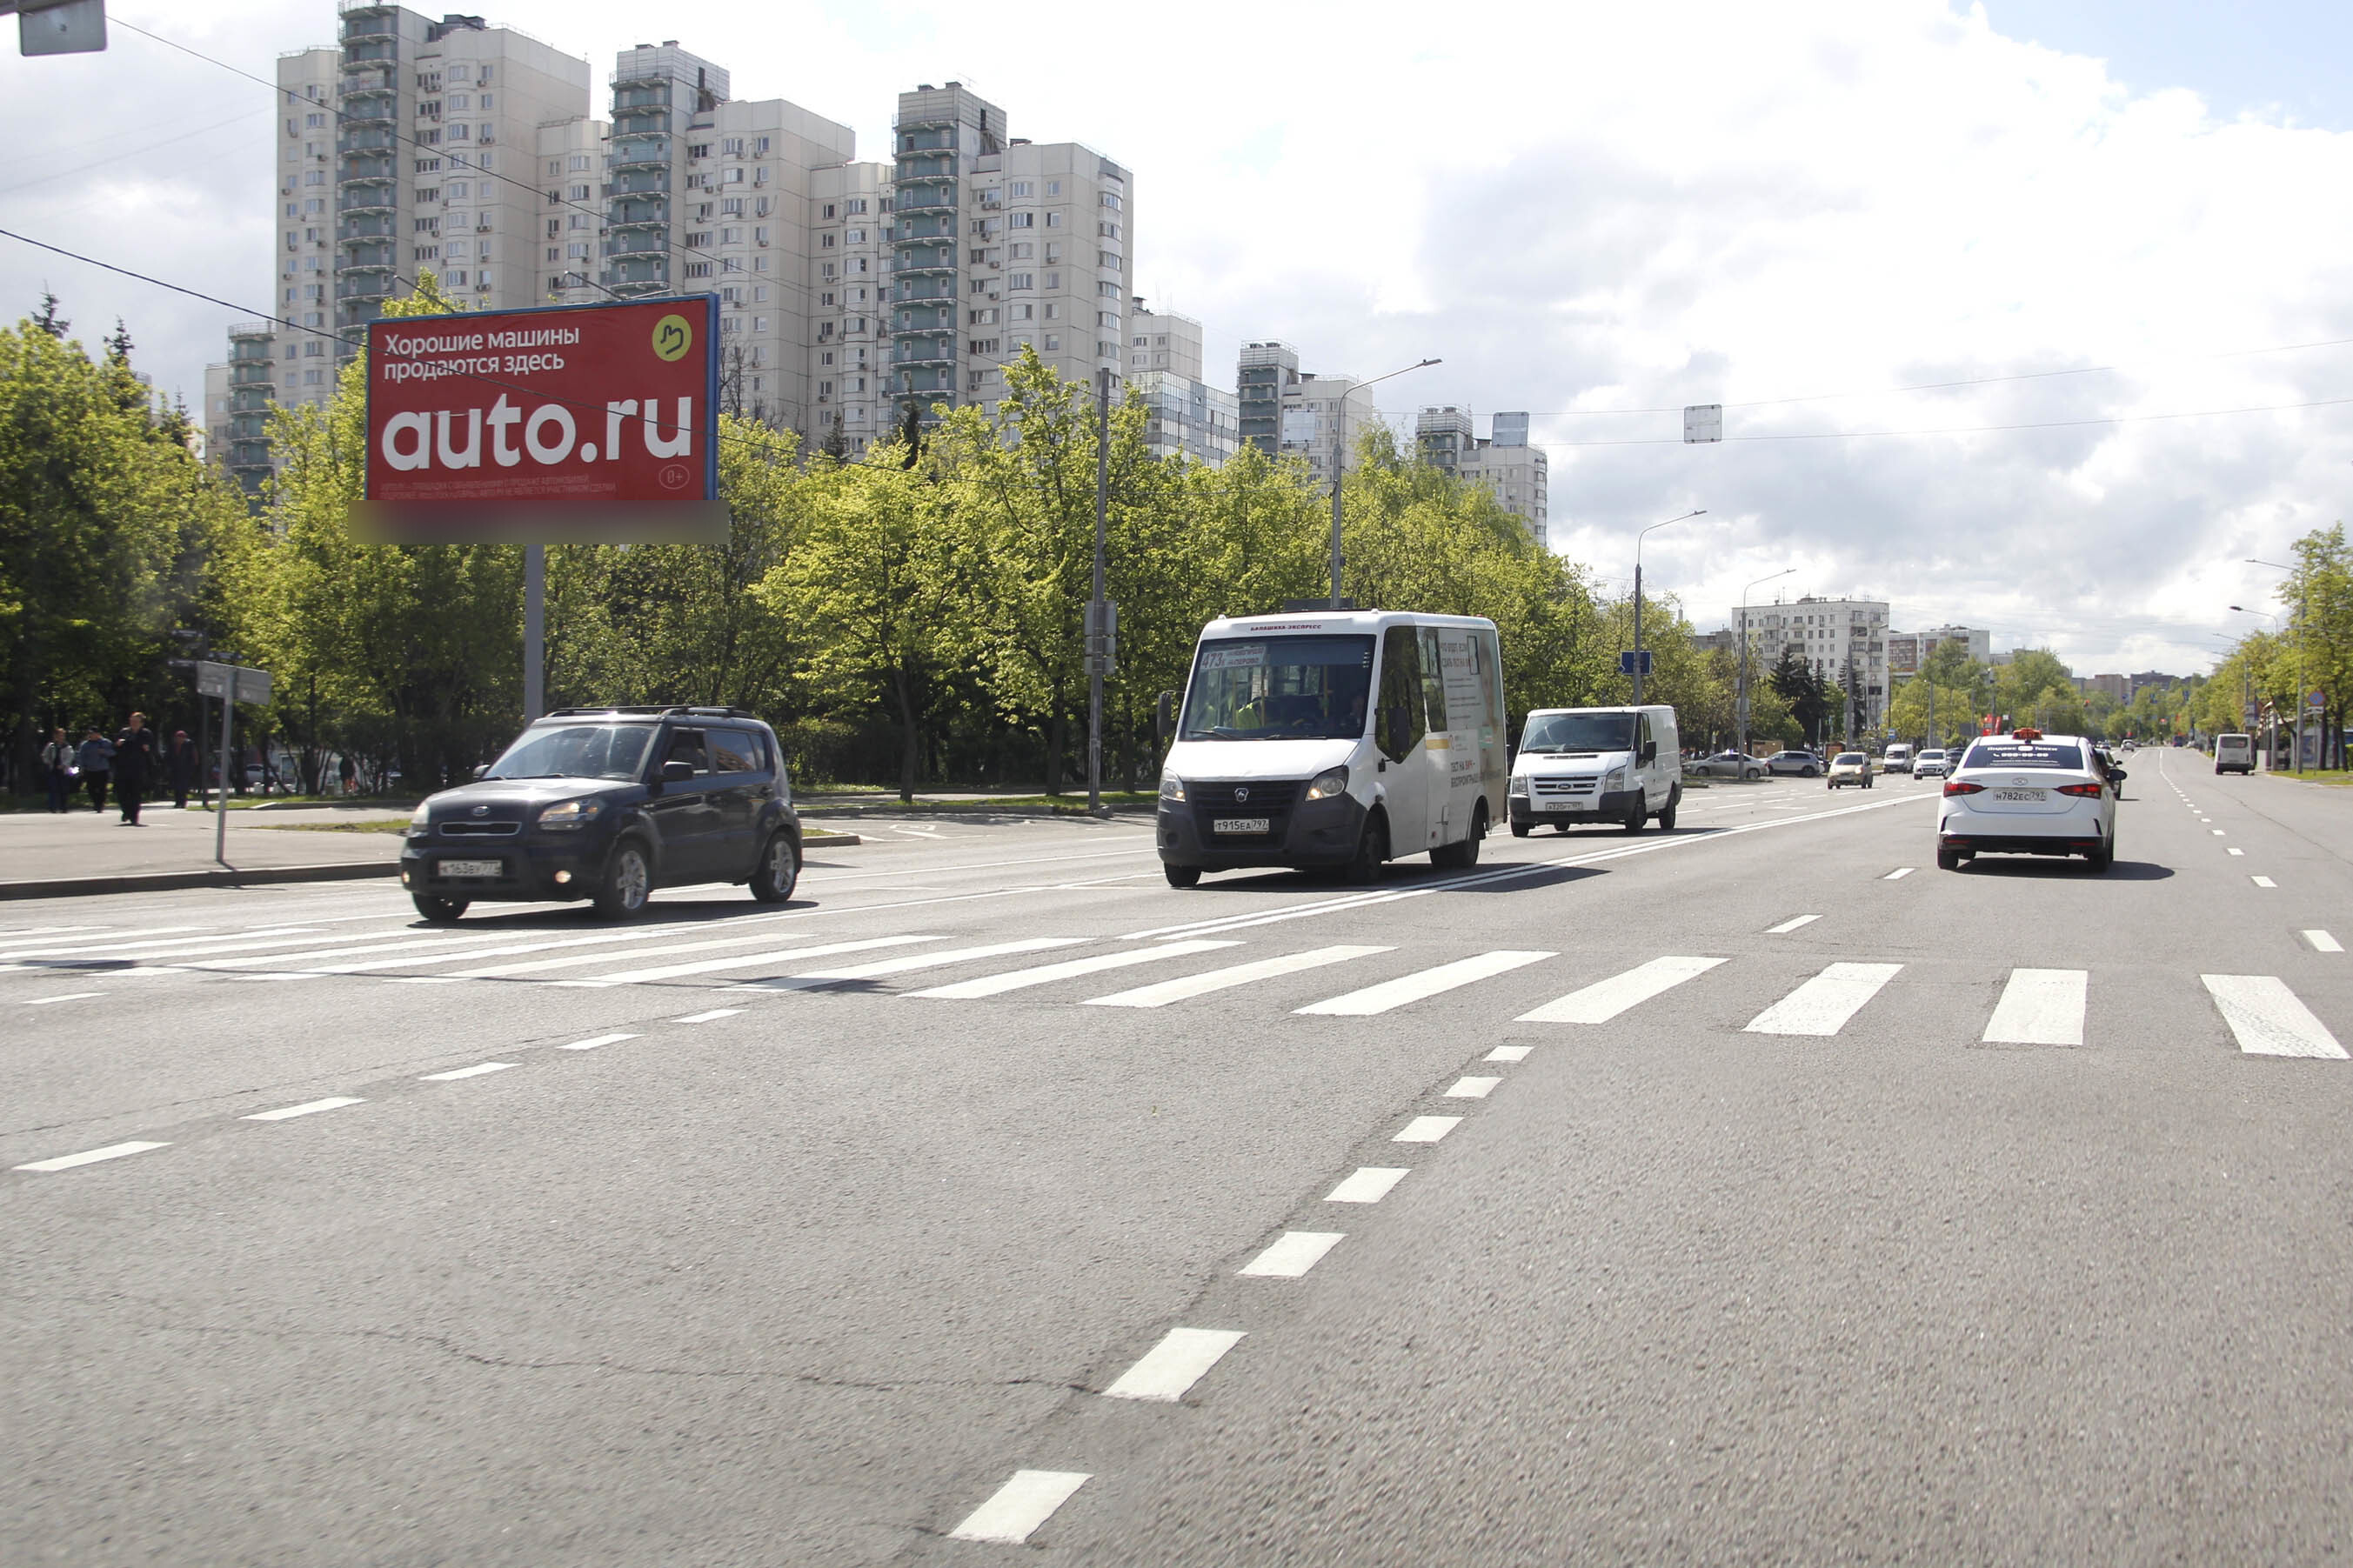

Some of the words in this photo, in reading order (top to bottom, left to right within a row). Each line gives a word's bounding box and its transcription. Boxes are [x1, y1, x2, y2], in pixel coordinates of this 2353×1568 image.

[384, 333, 483, 358] Хорошие
[487, 328, 580, 350] машины
[384, 357, 499, 384] продаются
[504, 353, 565, 375] здесь
[381, 392, 692, 471] auto.ru
[1218, 820, 1251, 830] Т915ЕА
